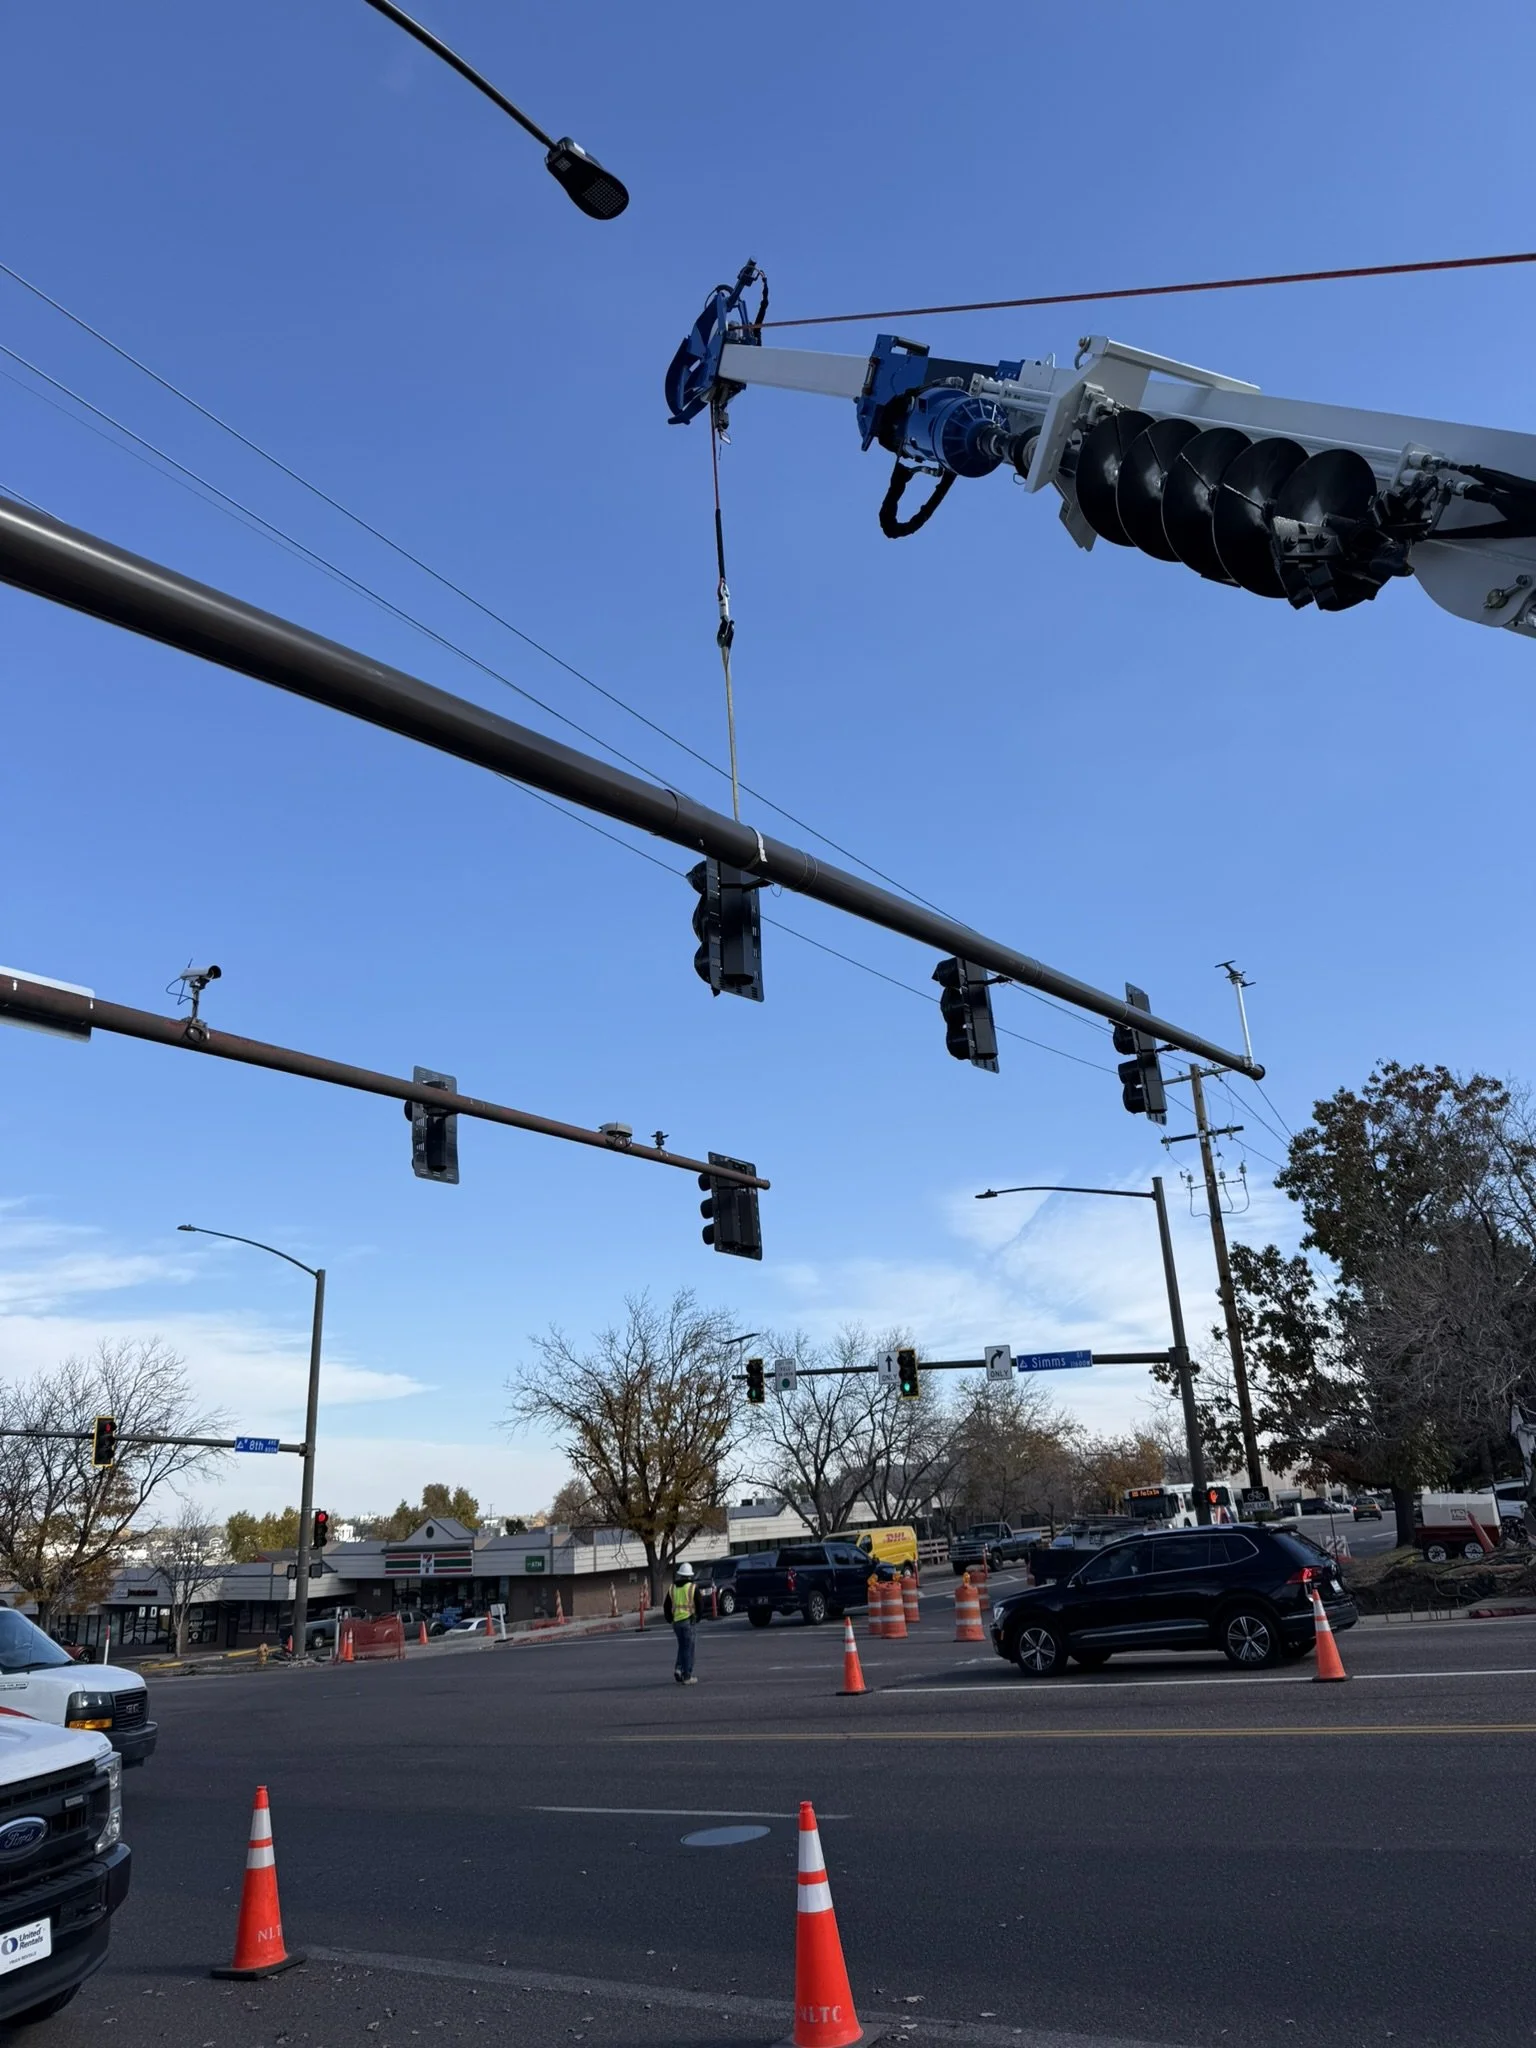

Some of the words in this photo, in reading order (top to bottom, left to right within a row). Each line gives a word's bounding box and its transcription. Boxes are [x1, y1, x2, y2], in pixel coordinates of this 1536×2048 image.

[1032, 1356, 1066, 1369] Simms
[990, 1369, 1009, 1378] ONLY
[249, 1439, 265, 1451] 8th
[885, 1531, 906, 1543] DHL
[4, 1828, 35, 1849] Ford
[20, 1926, 43, 1942] United
[20, 1936, 44, 1950] Rentals
[800, 2004, 842, 2024] NLTC
